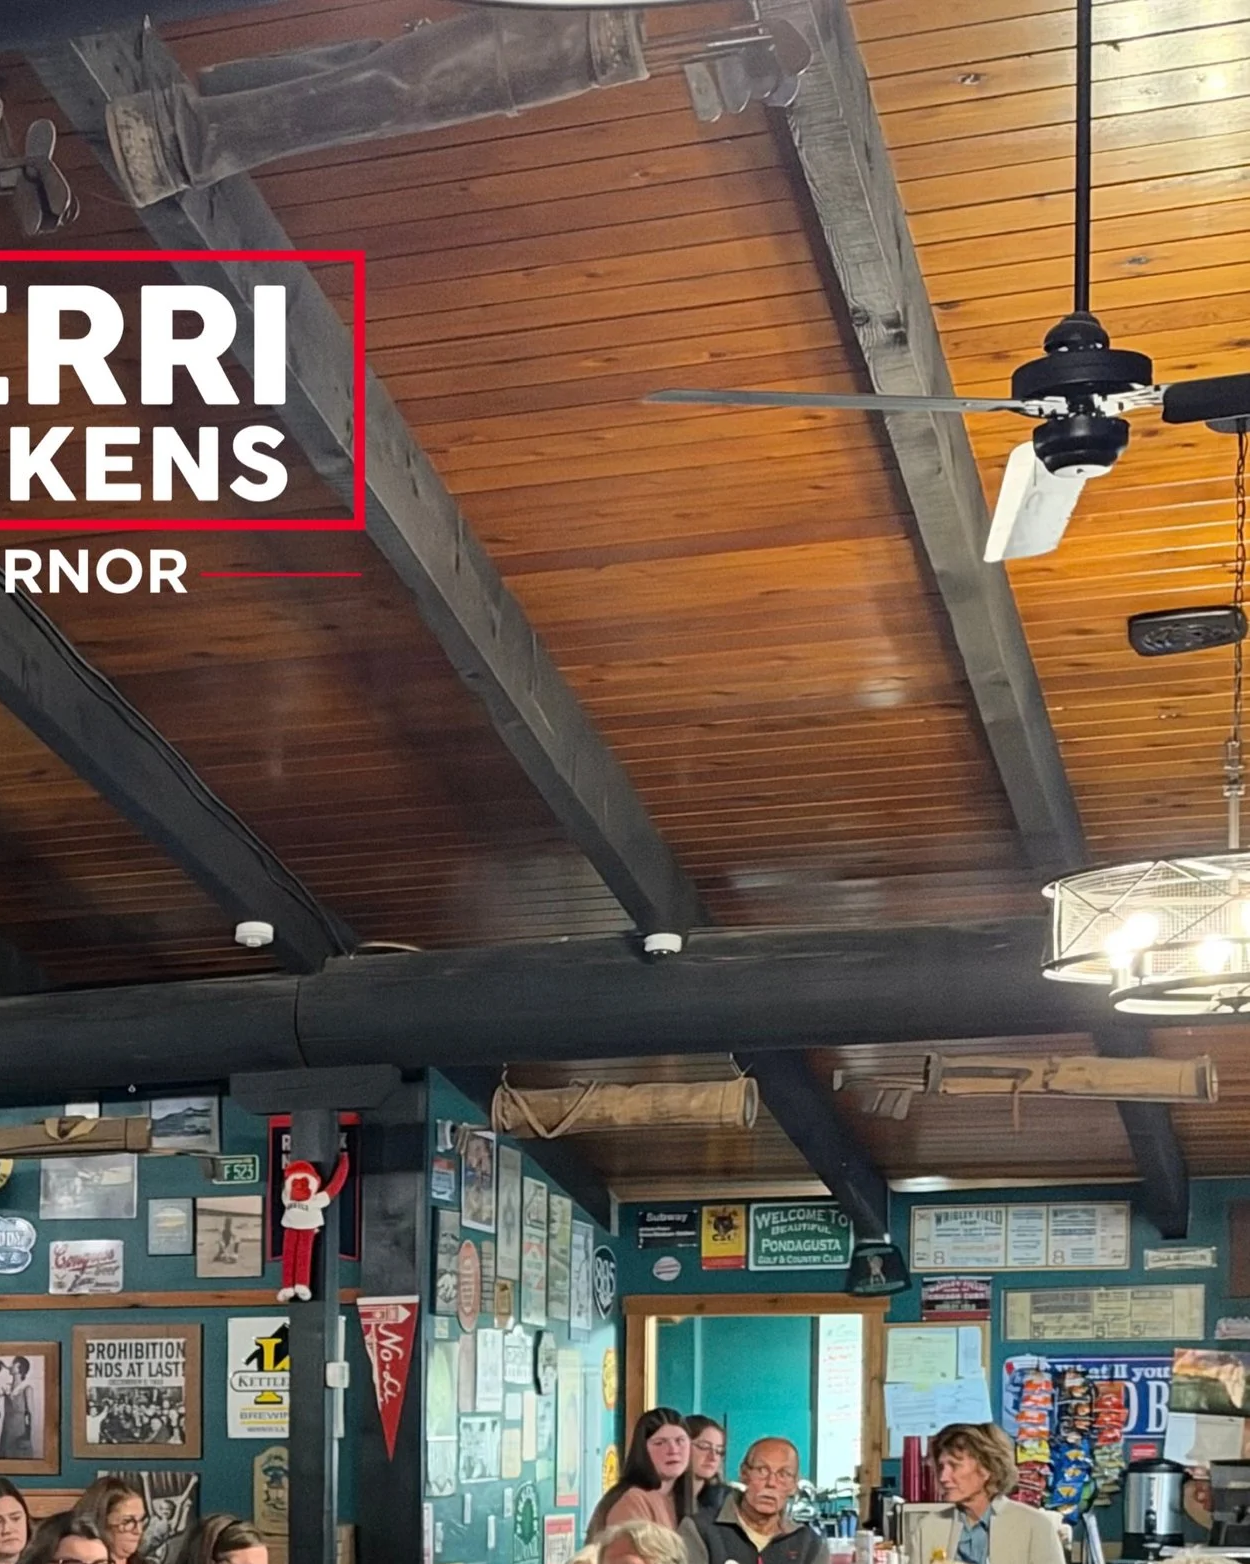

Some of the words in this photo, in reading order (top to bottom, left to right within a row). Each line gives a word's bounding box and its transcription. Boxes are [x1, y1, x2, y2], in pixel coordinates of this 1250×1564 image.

[755, 1207, 825, 1229] WELCOME
[831, 1210, 849, 1227] TO
[770, 1222, 833, 1236] BEAUTIFUL
[761, 1238, 842, 1253] PONDAGUSTA
[86, 1342, 186, 1360] PROHIBITION
[86, 1362, 122, 1378] ENDS
[126, 1362, 144, 1378] AT
[148, 1362, 186, 1378] LAST!
[1131, 1366, 1171, 1382] you
